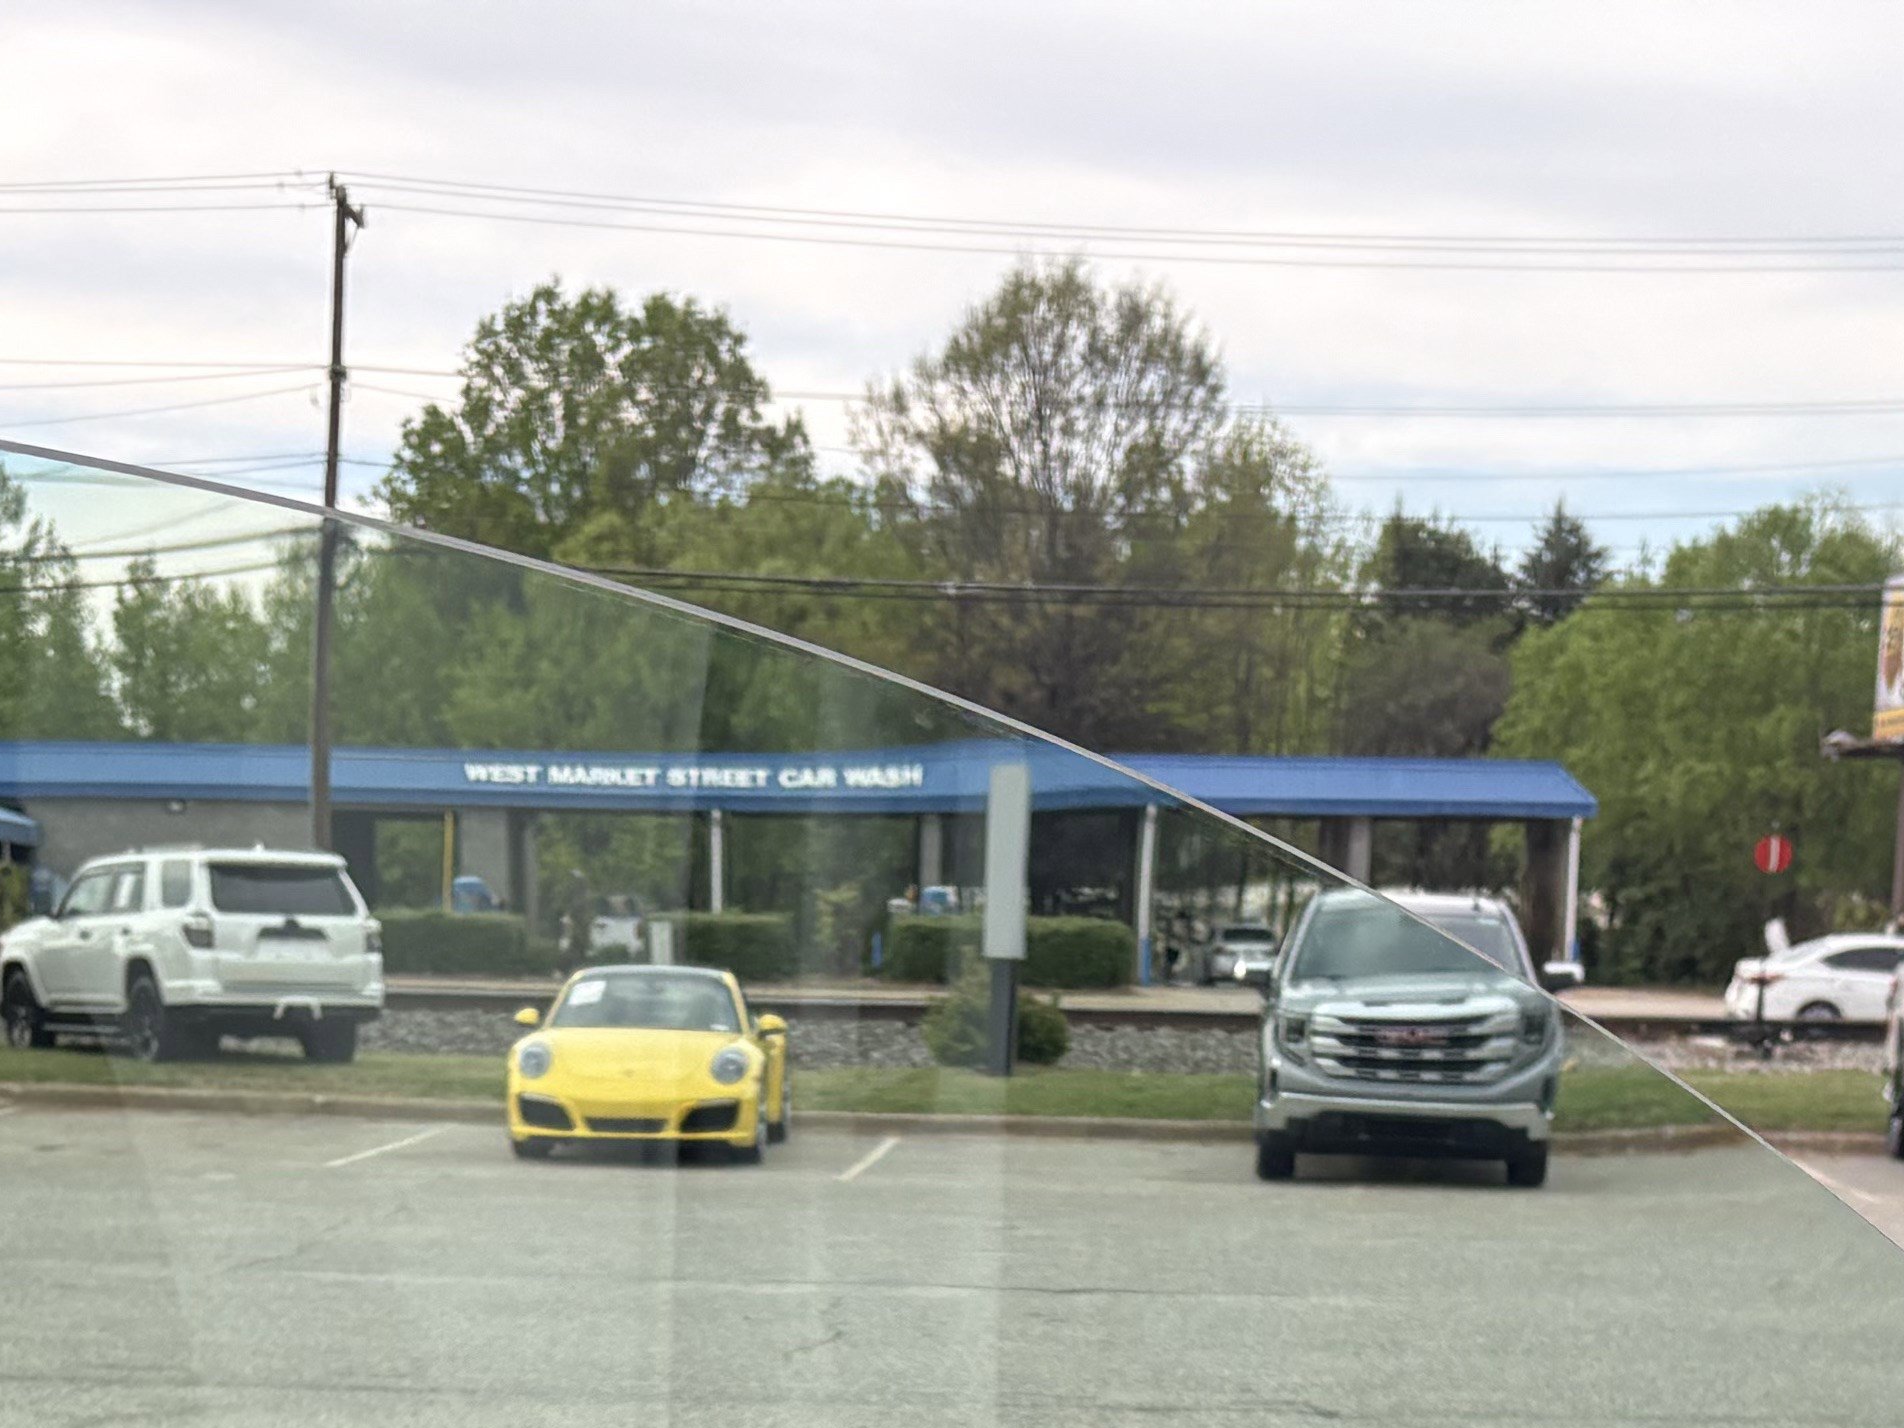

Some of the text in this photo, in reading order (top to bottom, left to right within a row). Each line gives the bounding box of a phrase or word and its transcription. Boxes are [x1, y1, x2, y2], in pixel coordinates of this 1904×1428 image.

[464, 762, 924, 788] WEST MARKET STREET CAR WASH
